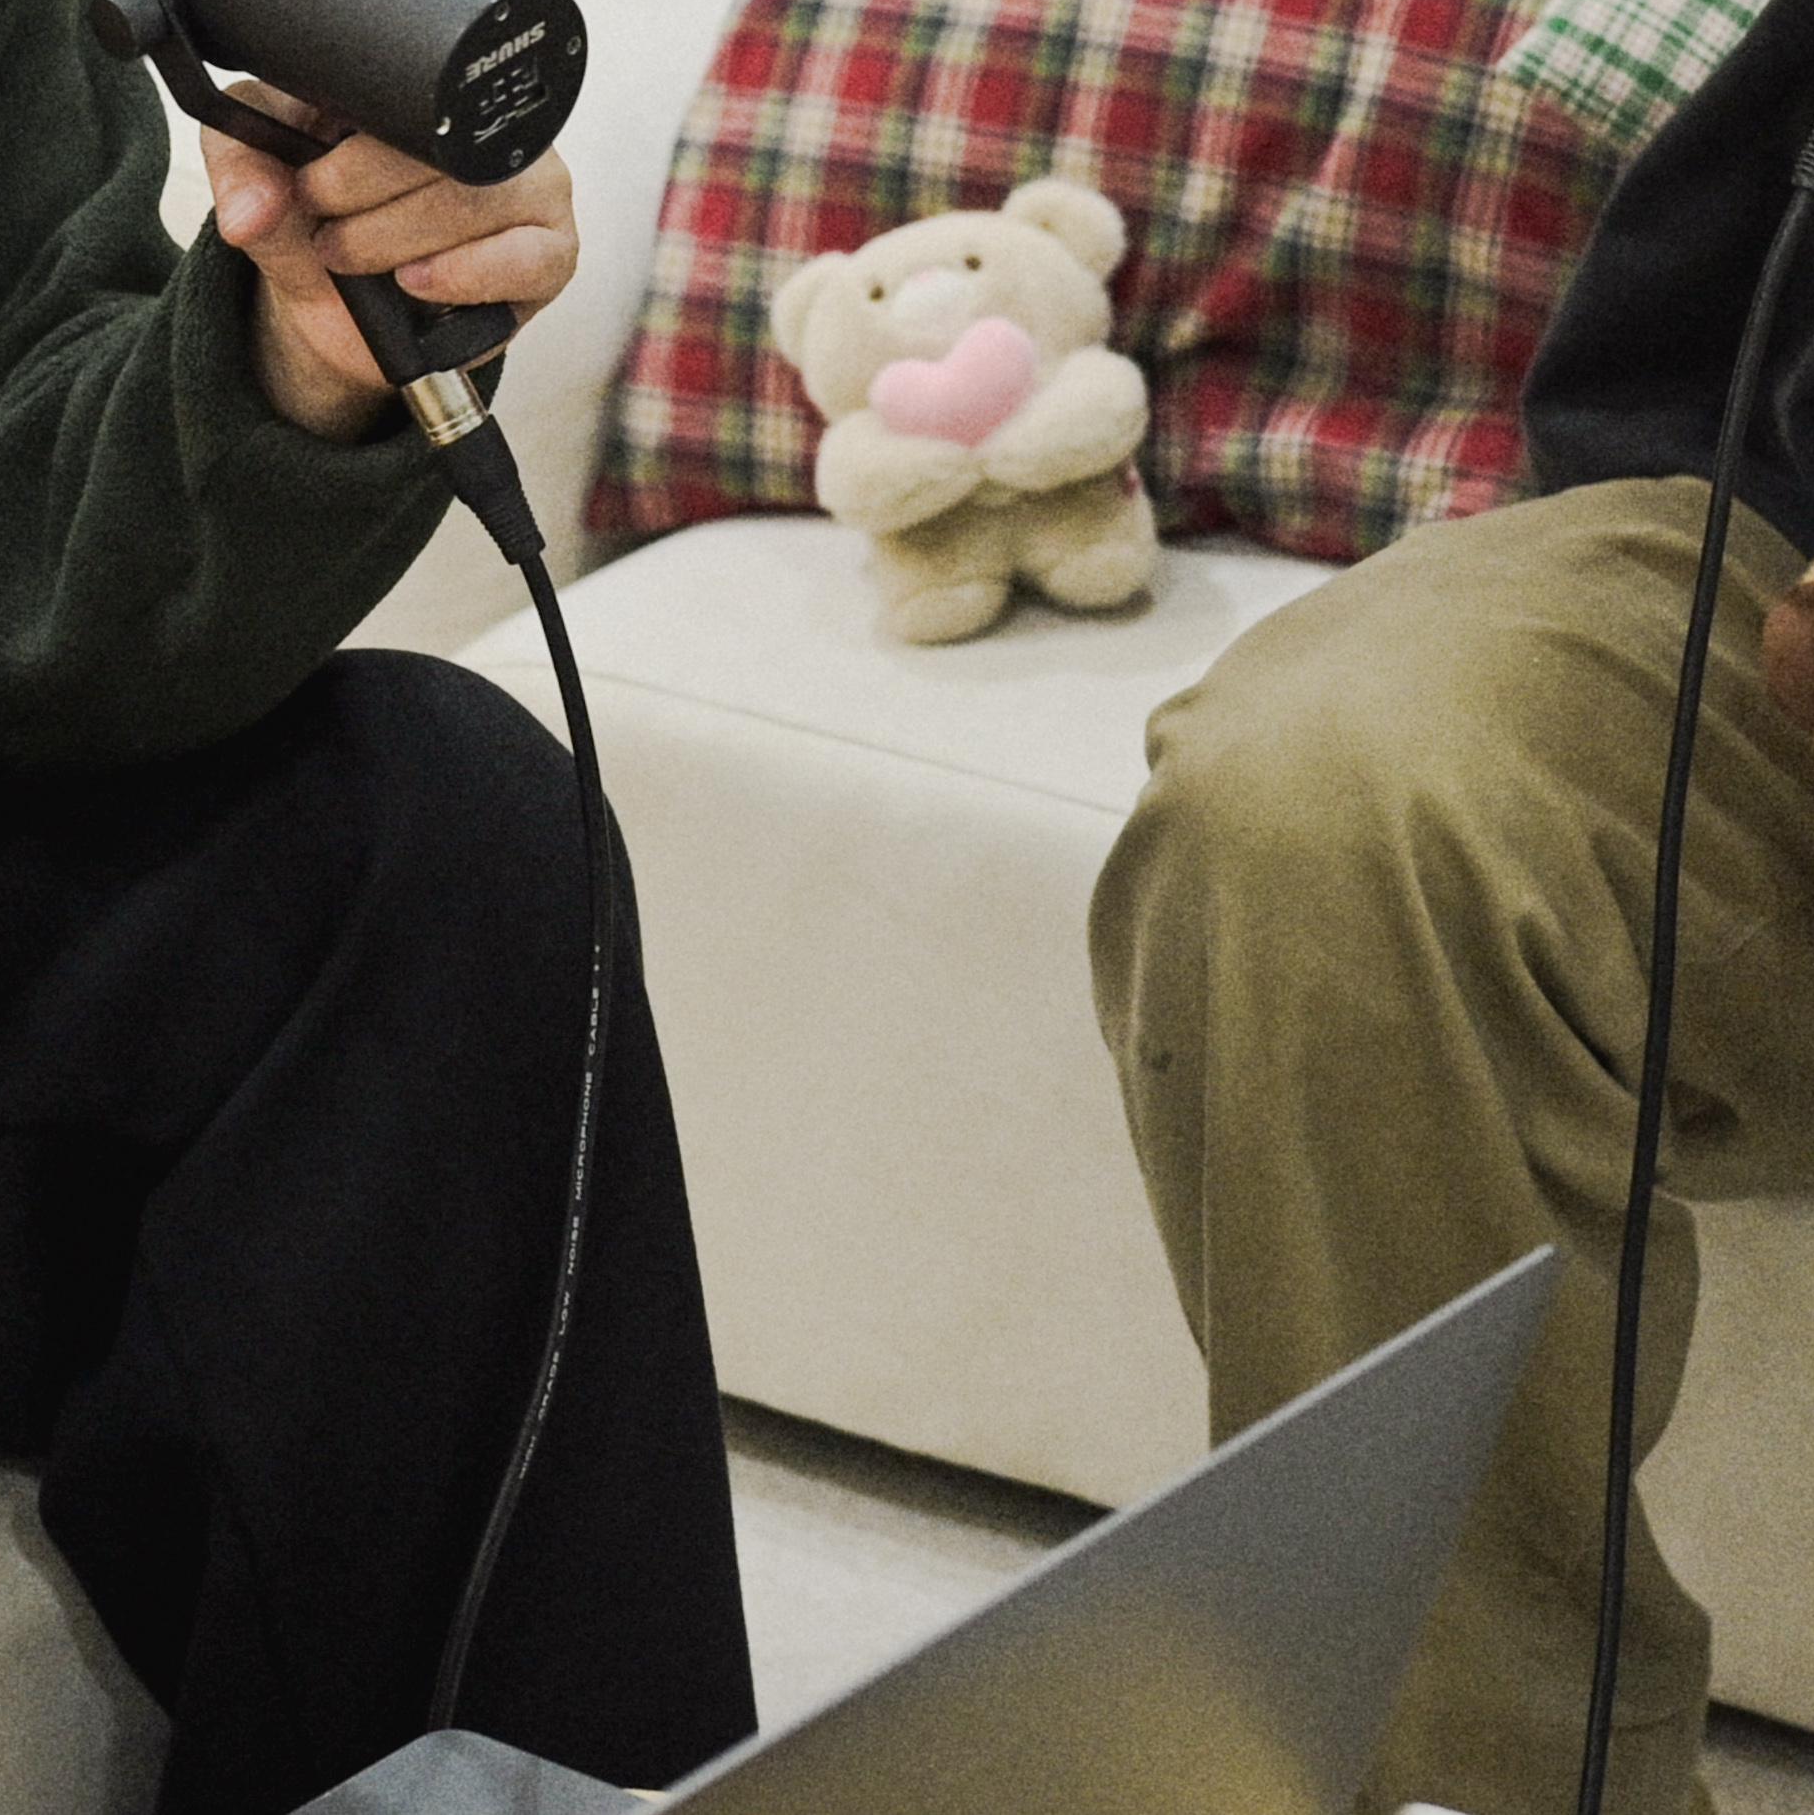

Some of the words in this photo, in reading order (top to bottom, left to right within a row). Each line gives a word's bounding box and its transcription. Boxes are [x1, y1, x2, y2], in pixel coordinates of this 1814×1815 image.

[465, 20, 546, 84] SHURE
[558, 1291, 570, 1335] LOW
[567, 1216, 580, 1275] NOISE
[575, 1071, 593, 1200] MICROPHONE
[588, 987, 599, 1056] CABLE
